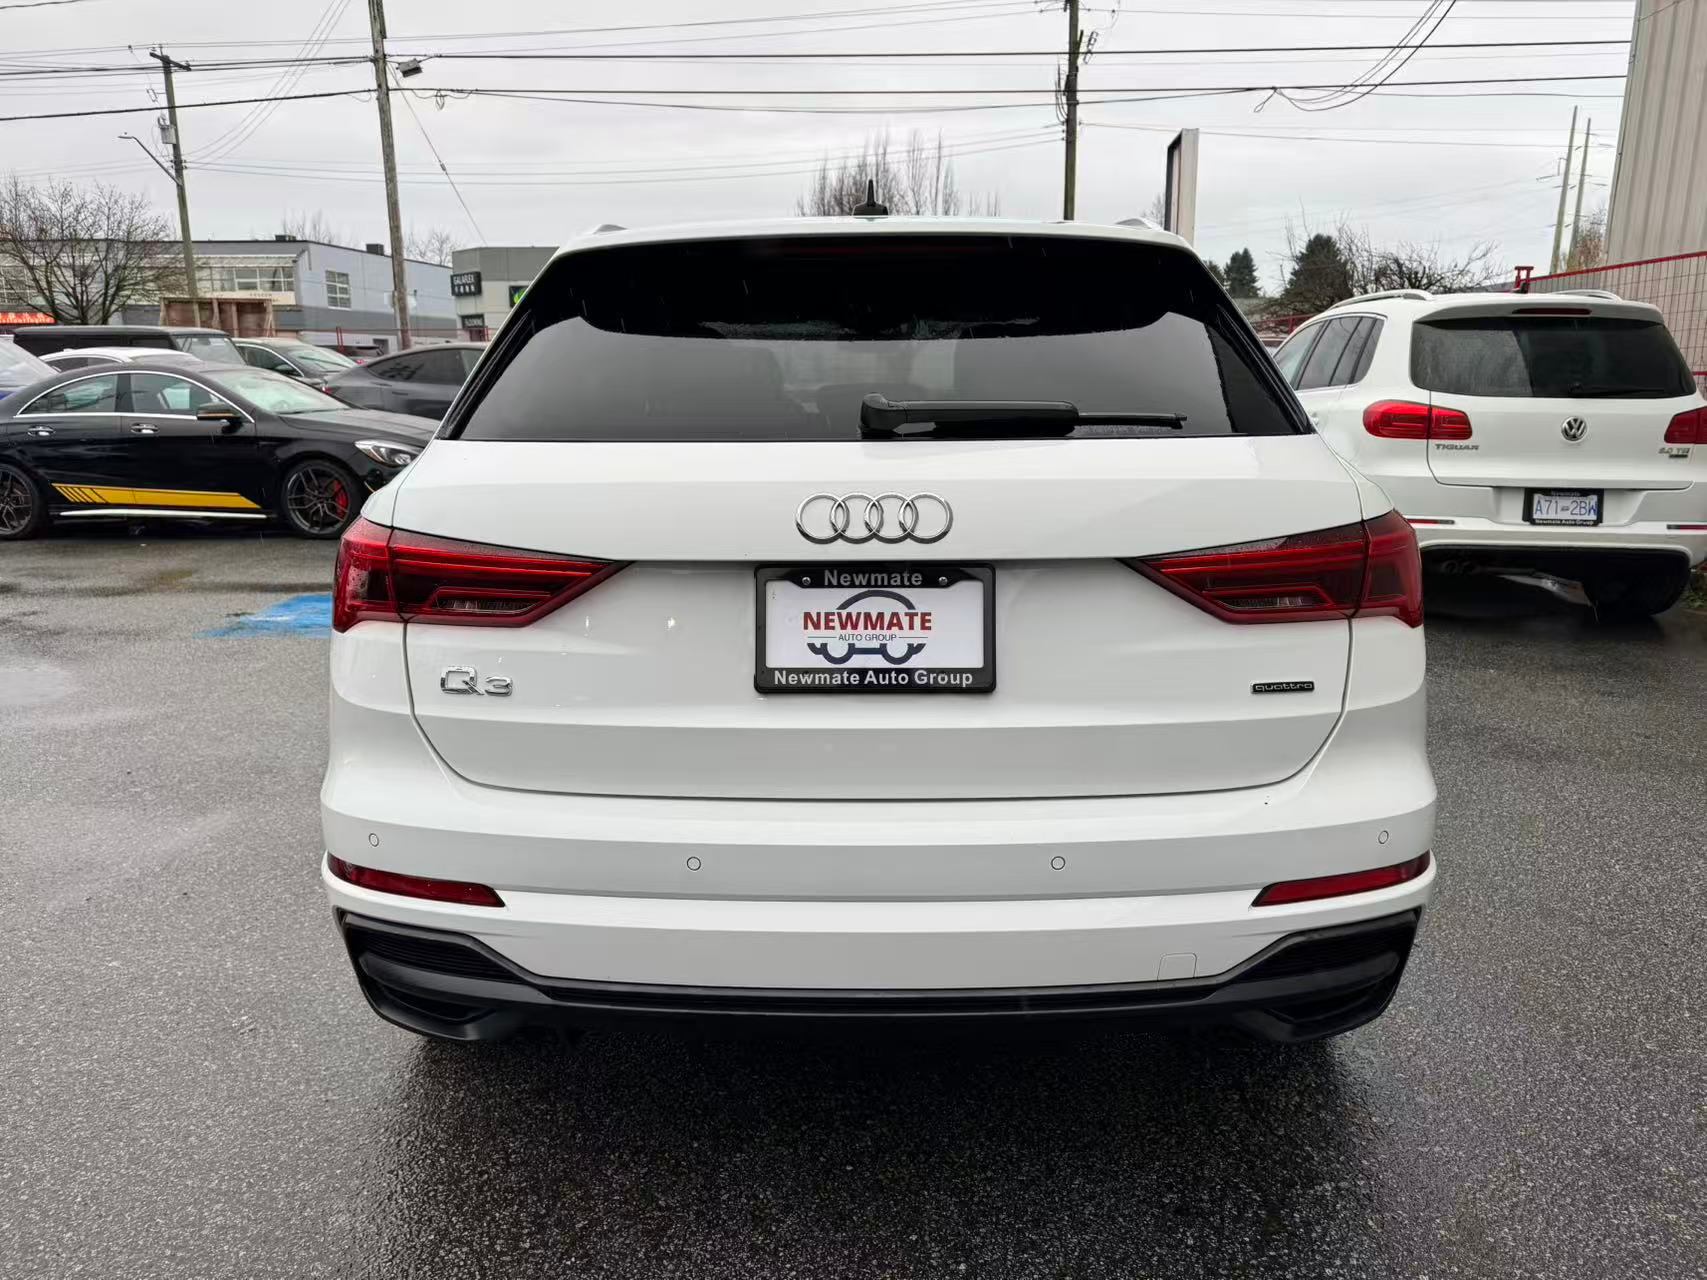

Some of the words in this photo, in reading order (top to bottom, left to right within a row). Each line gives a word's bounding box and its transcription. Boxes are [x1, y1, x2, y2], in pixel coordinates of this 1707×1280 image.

[1434, 443, 1479, 451] TIGUAN
[824, 569, 923, 586] Newmate
[803, 611, 932, 631] NEWMATE
[838, 633, 863, 641] AUTO
[864, 633, 897, 641] GROUP
[440, 665, 513, 697] Q3
[774, 670, 862, 685] Newmate
[864, 670, 909, 685] Auto
[914, 670, 973, 687] Group
[1255, 682, 1313, 692] quattro
